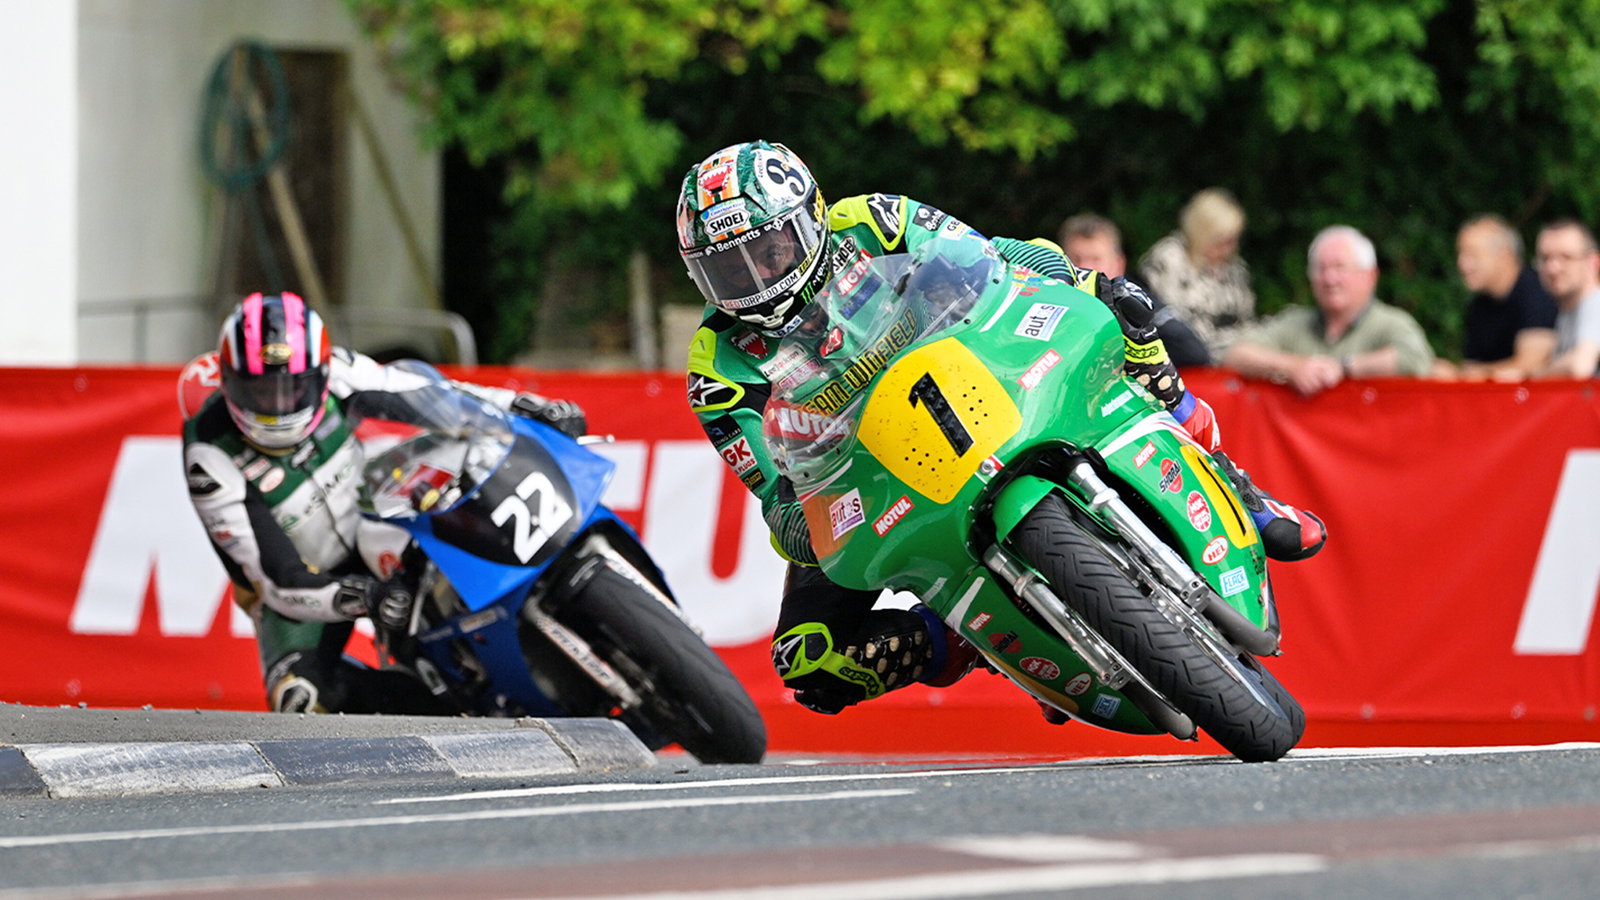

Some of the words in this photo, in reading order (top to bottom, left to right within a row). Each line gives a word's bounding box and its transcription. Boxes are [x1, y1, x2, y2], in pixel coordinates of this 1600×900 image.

[766, 158, 806, 197] 3
[709, 211, 744, 234] SHOEI
[716, 229, 761, 253] Bennetts
[837, 253, 872, 296] MOTUL
[1020, 350, 1060, 390] MOTUL
[908, 371, 975, 459] 1
[723, 438, 751, 467] GK
[1159, 459, 1182, 494] SHORAI
[491, 471, 573, 564] 22
[875, 498, 912, 535] MOTUL
[1207, 544, 1226, 562] HEL
[968, 613, 991, 631] MOTUL
[1070, 679, 1090, 696] HEL
